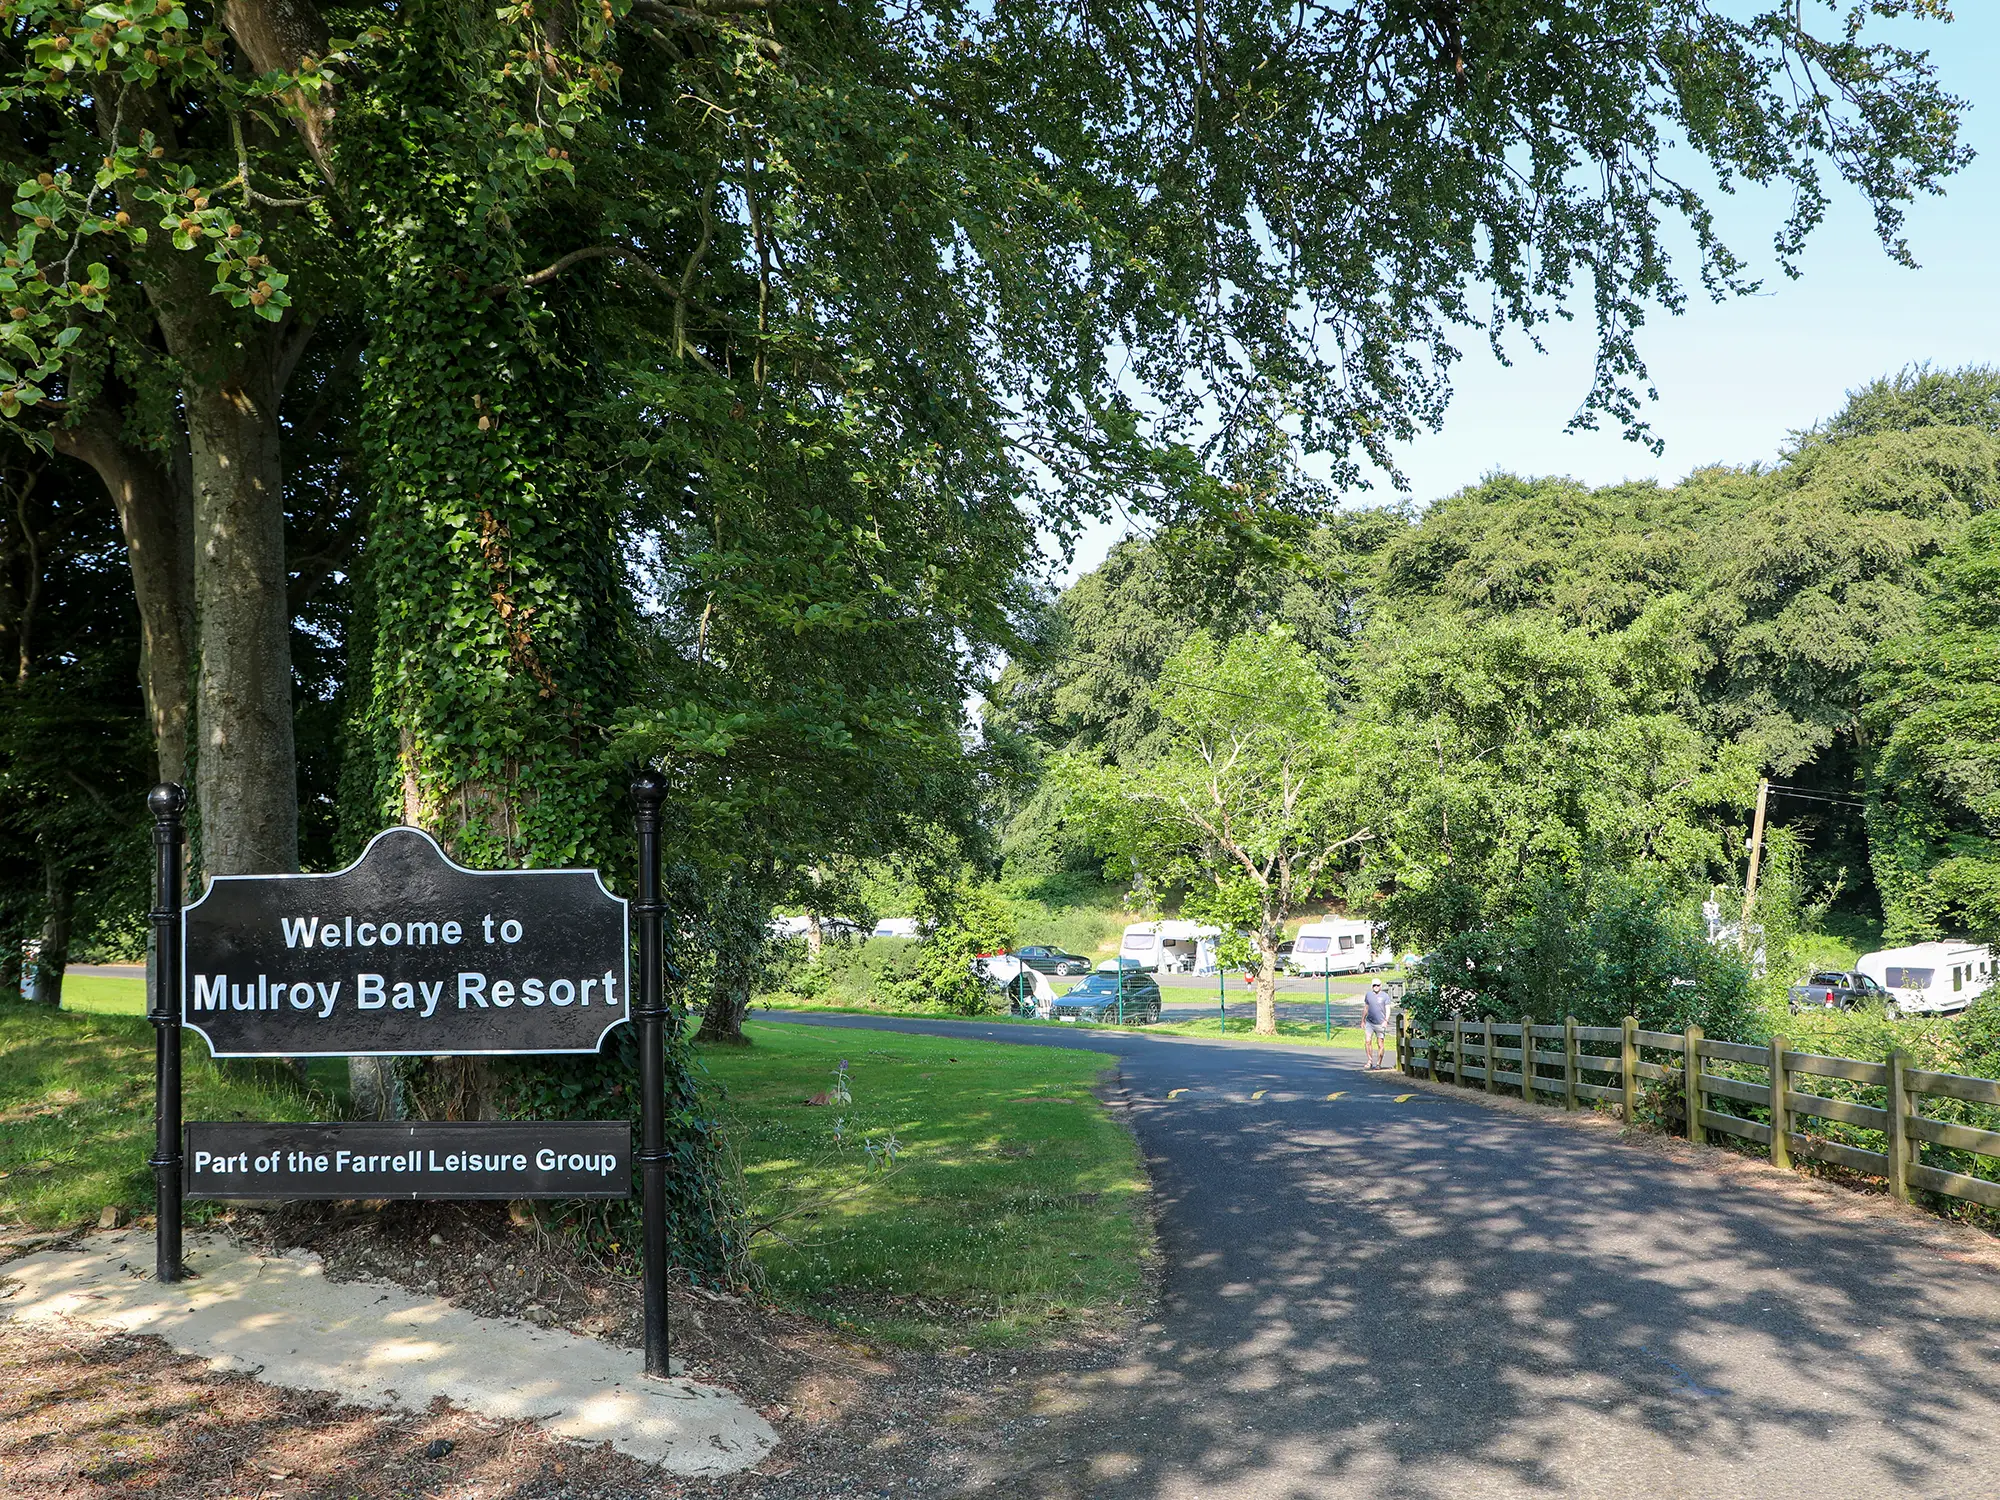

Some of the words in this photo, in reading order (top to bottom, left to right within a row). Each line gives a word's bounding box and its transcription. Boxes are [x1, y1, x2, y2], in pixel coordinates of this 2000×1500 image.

[280, 915, 463, 949] Welcome
[481, 913, 523, 944] to
[194, 974, 341, 1018] Mulroy
[357, 972, 444, 1018] Bay
[457, 969, 619, 1009] Resort
[195, 1151, 248, 1174] Part
[254, 1150, 281, 1173] of
[287, 1150, 329, 1173] the
[336, 1150, 422, 1173] Farrell
[428, 1149, 527, 1172] Leisure
[535, 1148, 617, 1177] Group
